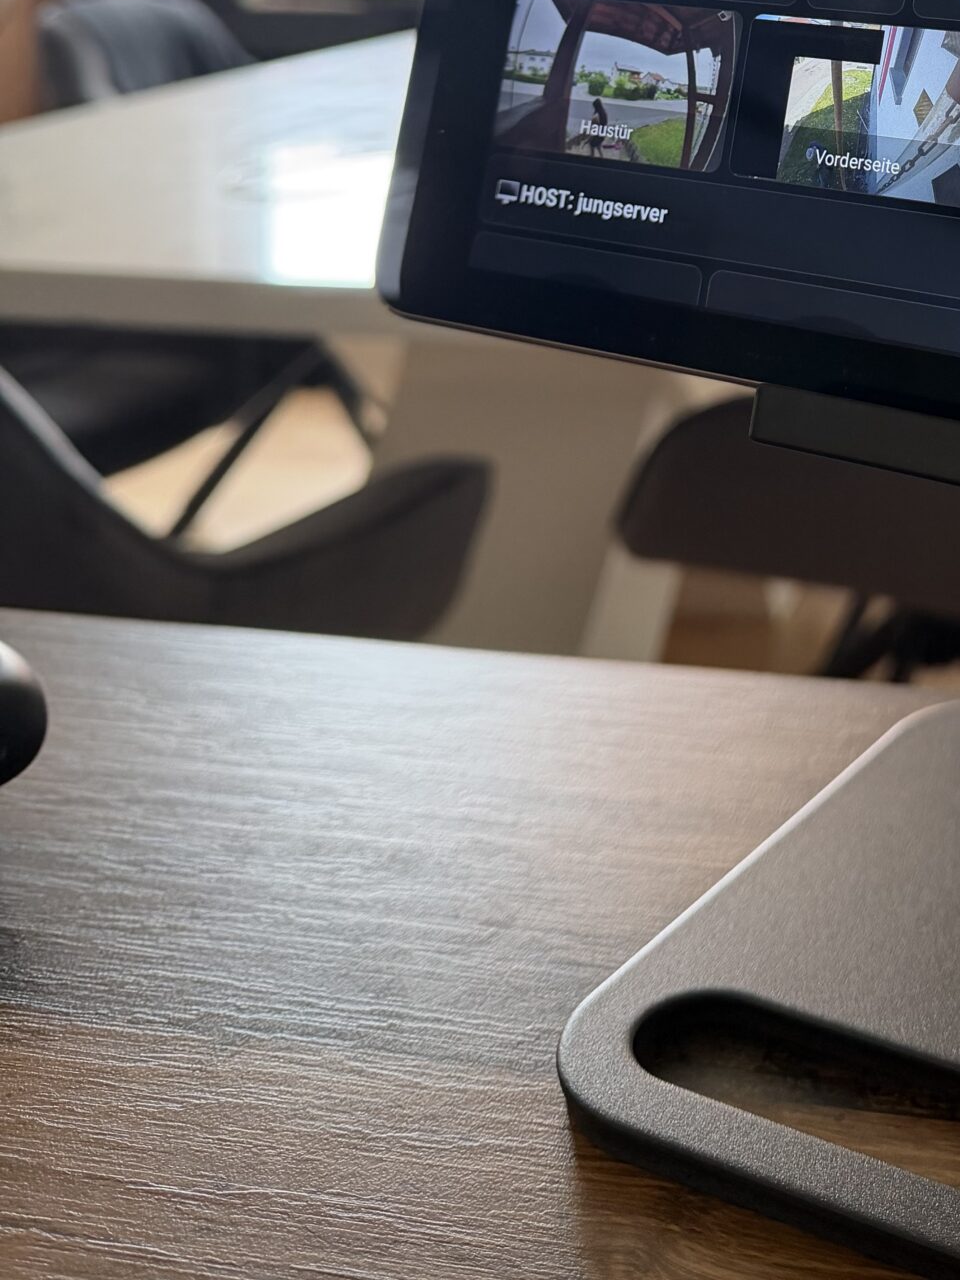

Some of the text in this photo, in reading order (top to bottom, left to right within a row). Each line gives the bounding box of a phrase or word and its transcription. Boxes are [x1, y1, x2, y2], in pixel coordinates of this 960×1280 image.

[580, 119, 634, 142] Haustür
[814, 149, 900, 176] Vorderseite
[519, 184, 669, 224] HOST: jungserver
